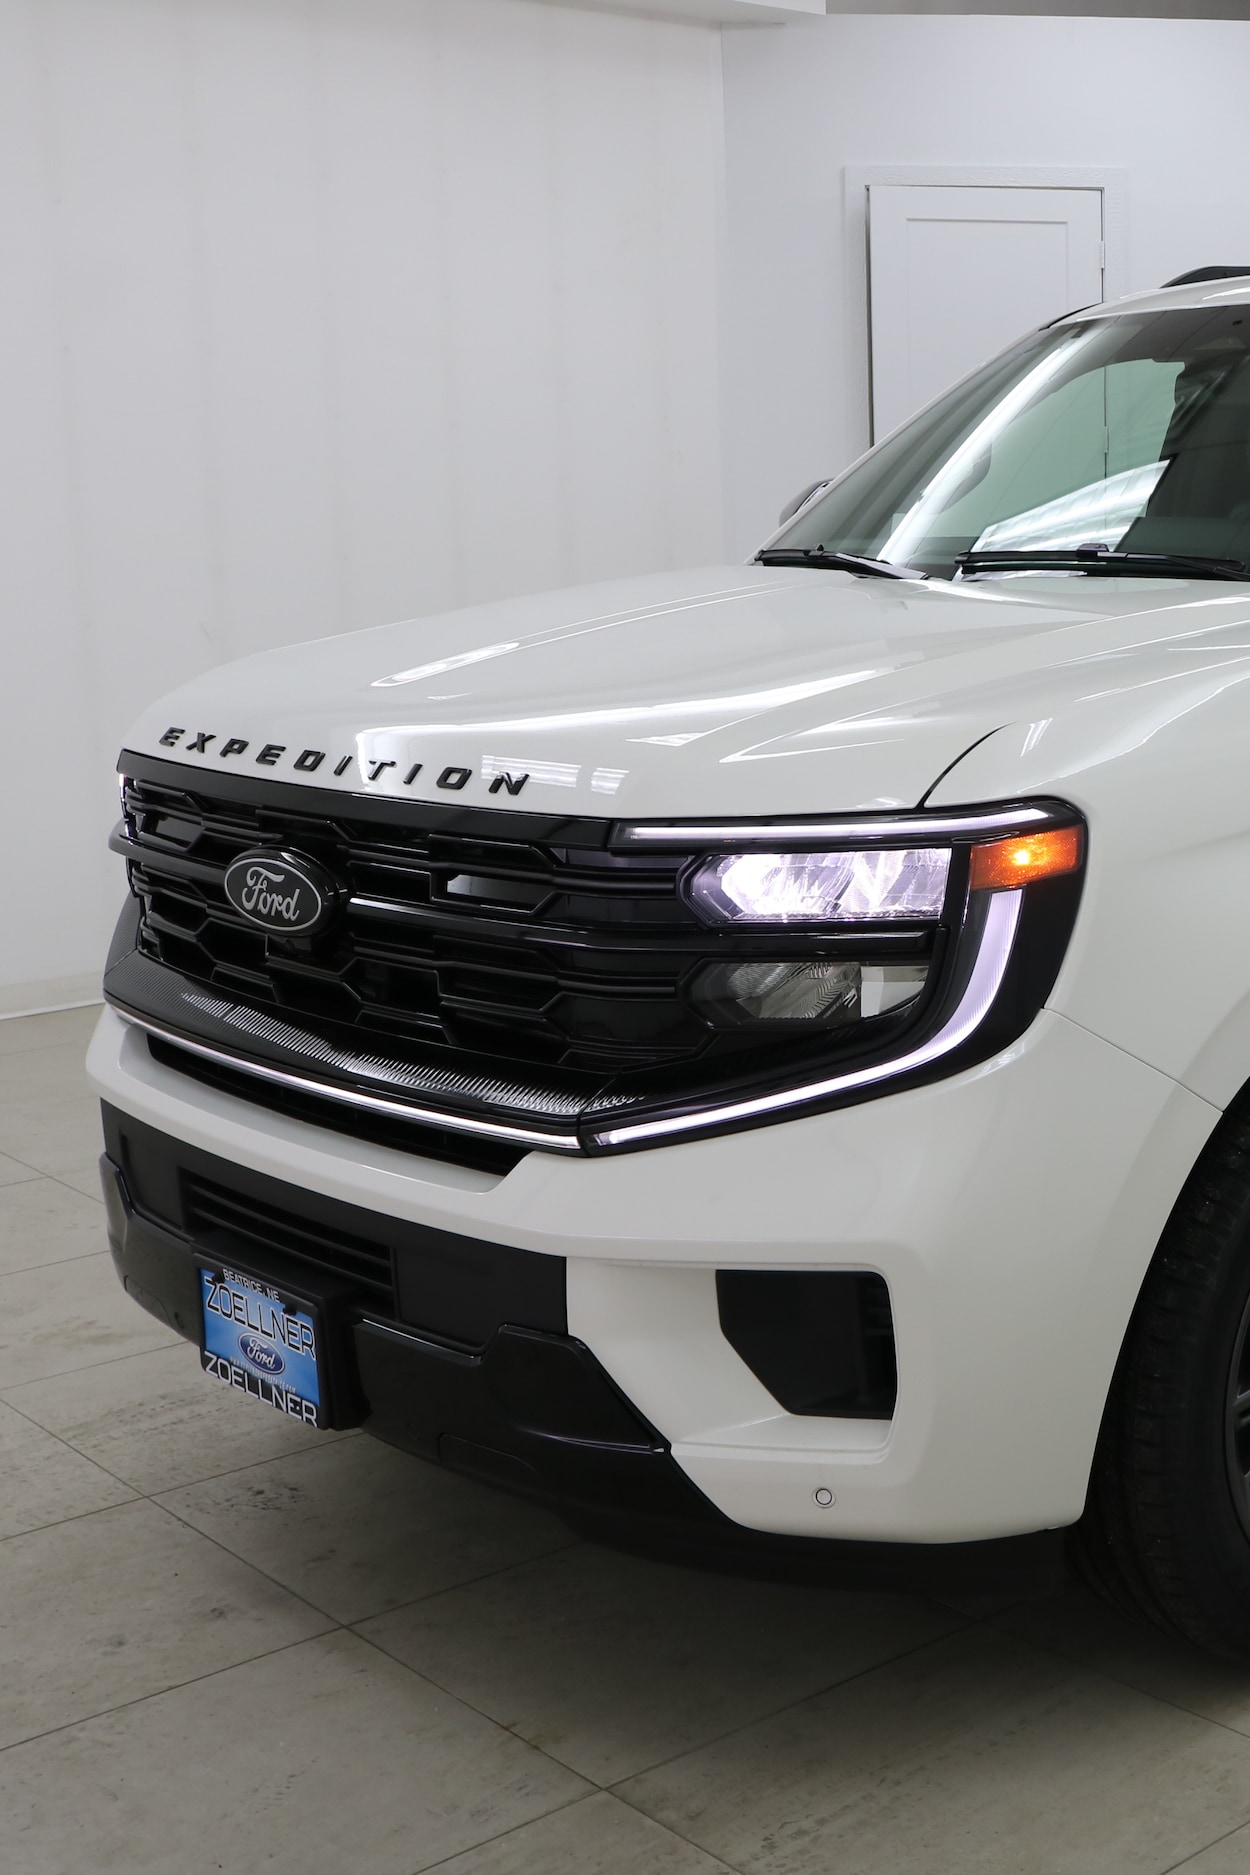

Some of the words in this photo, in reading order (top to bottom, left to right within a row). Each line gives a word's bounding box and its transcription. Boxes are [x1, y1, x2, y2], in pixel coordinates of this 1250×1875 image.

[159, 727, 530, 796] EXPEDITION
[241, 866, 301, 922] Ford
[204, 1275, 316, 1361] ZOELLNER
[266, 1287, 281, 1304] NE
[246, 1339, 276, 1370] Ford
[204, 1350, 318, 1428] ZOELLNER
